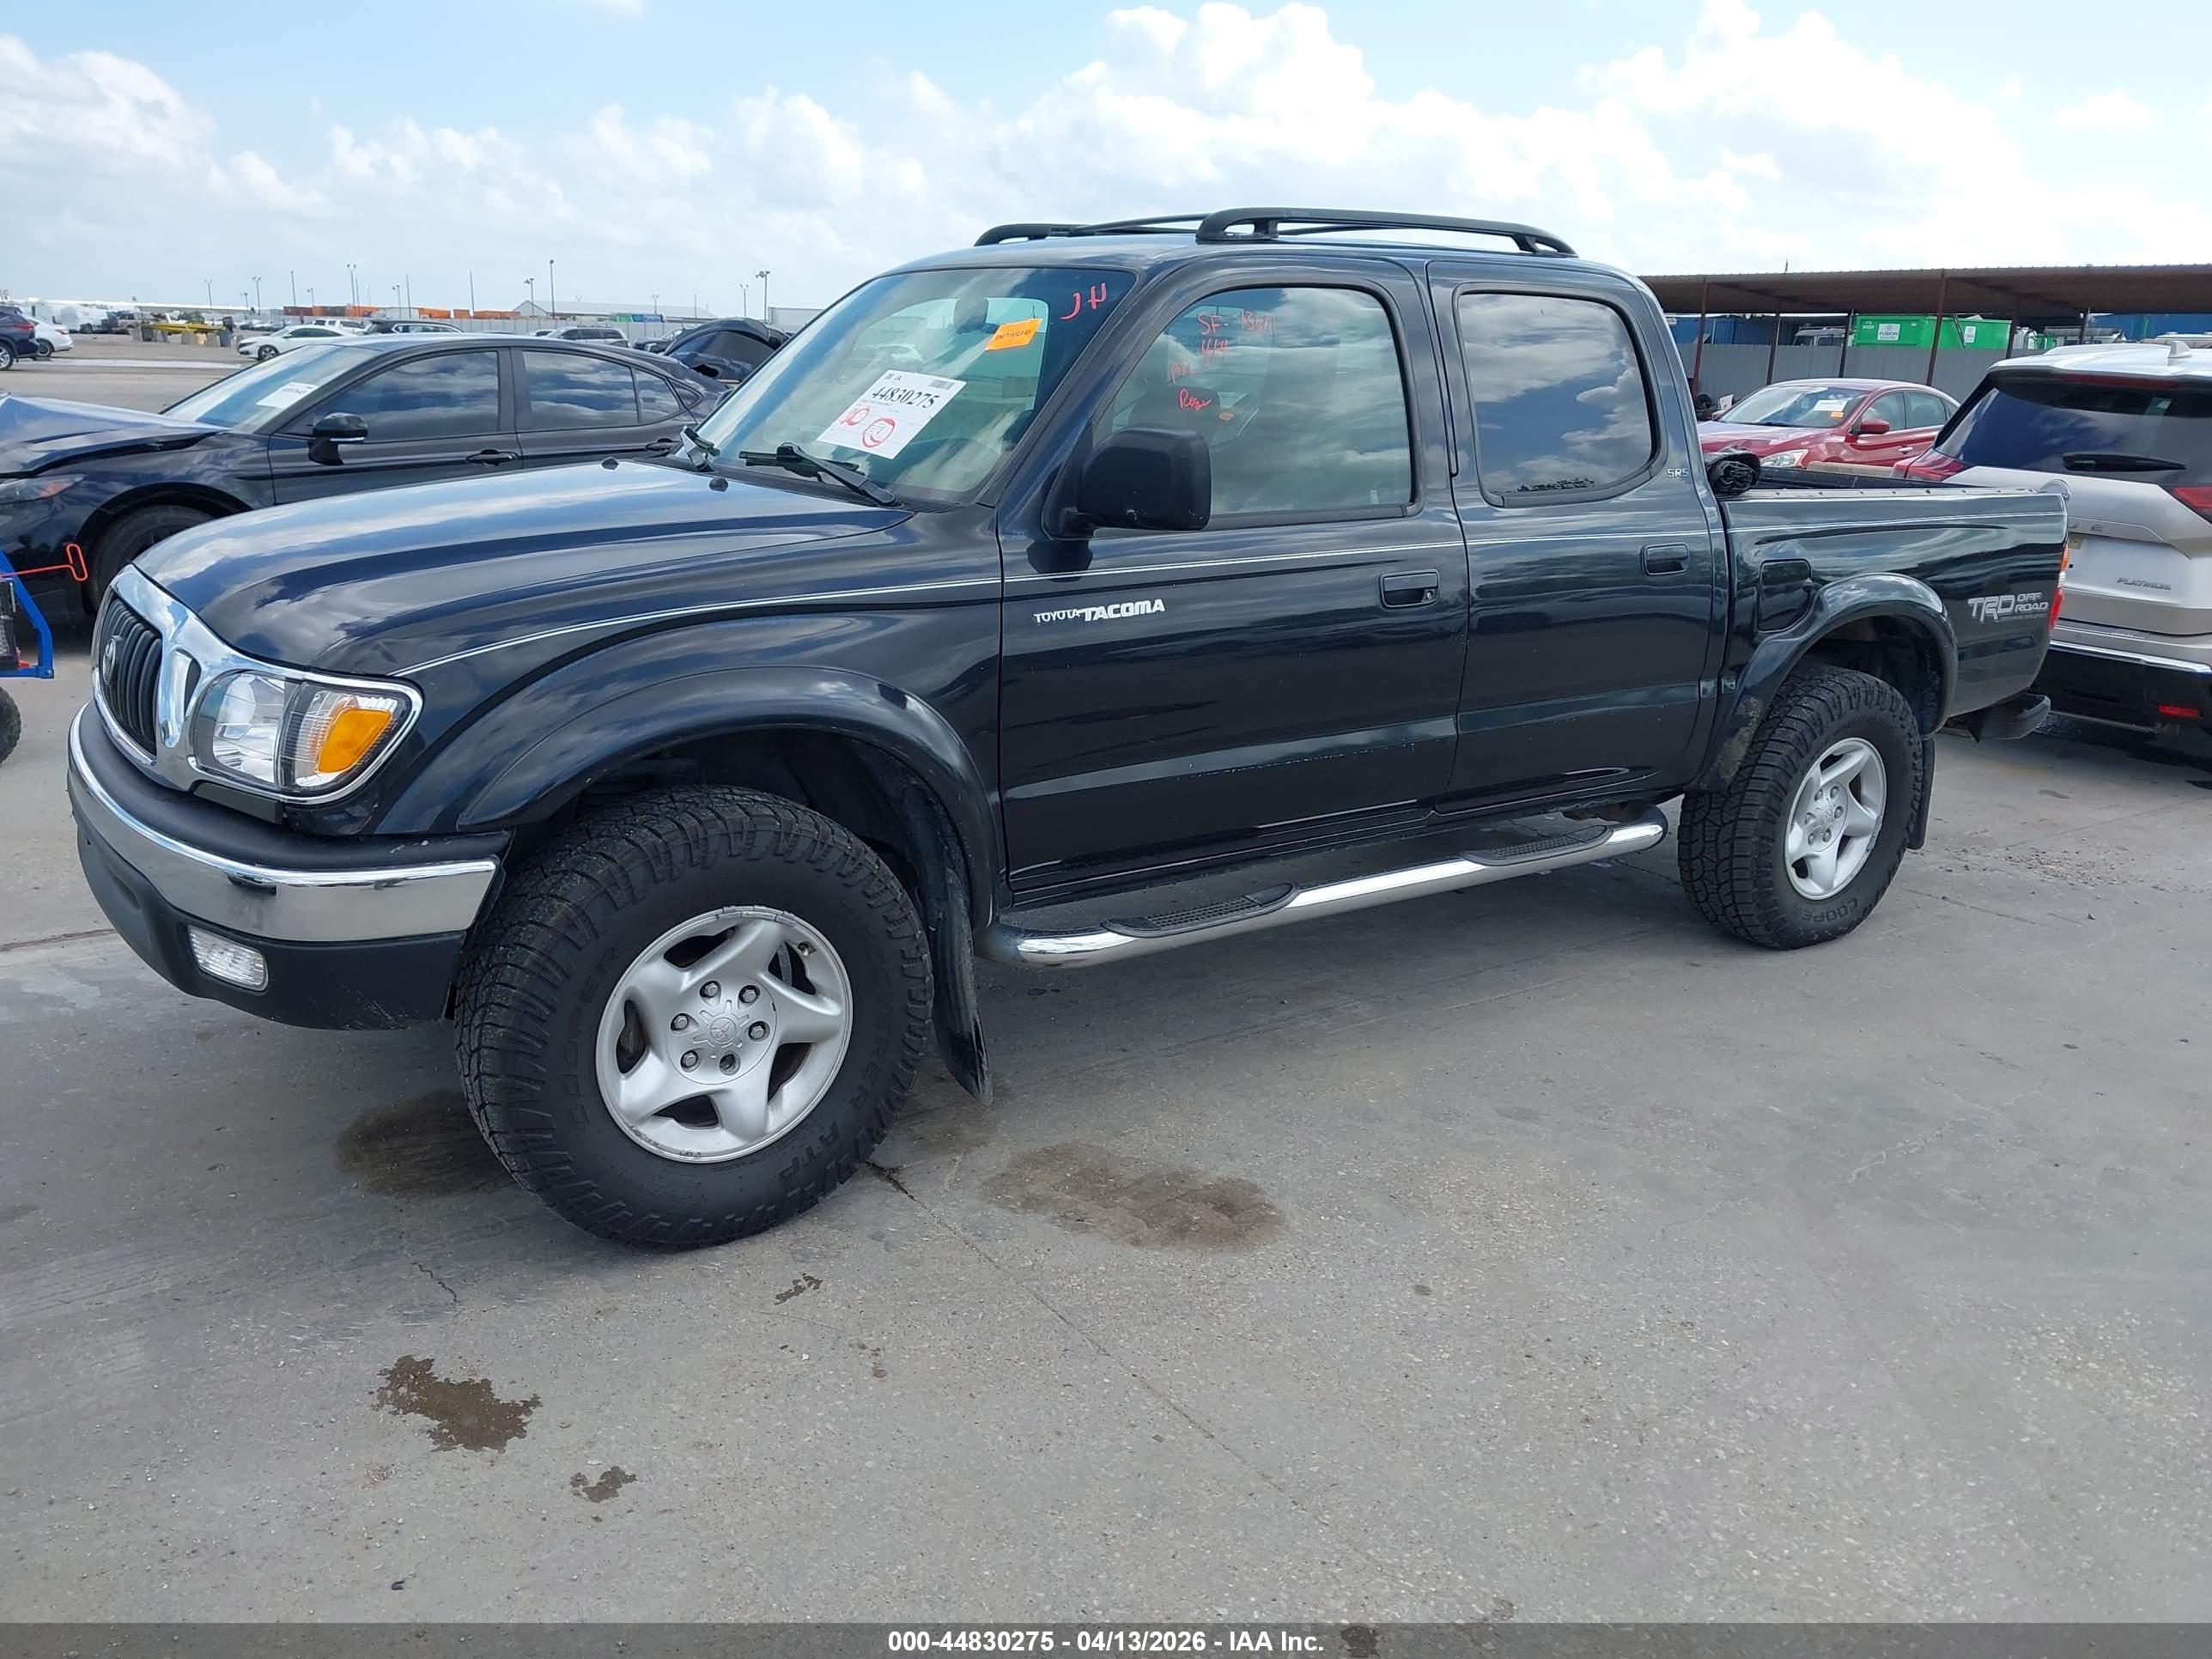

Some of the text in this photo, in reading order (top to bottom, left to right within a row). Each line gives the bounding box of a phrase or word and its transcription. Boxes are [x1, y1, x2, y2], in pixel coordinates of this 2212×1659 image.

[872, 386, 940, 409] 44830275
[2116, 576, 2172, 592] PLATINUM
[1033, 599, 1166, 623] TOYOTA TACOMA
[1967, 592, 2043, 623] TRD OFF
[2014, 601, 2050, 612] ROAD
